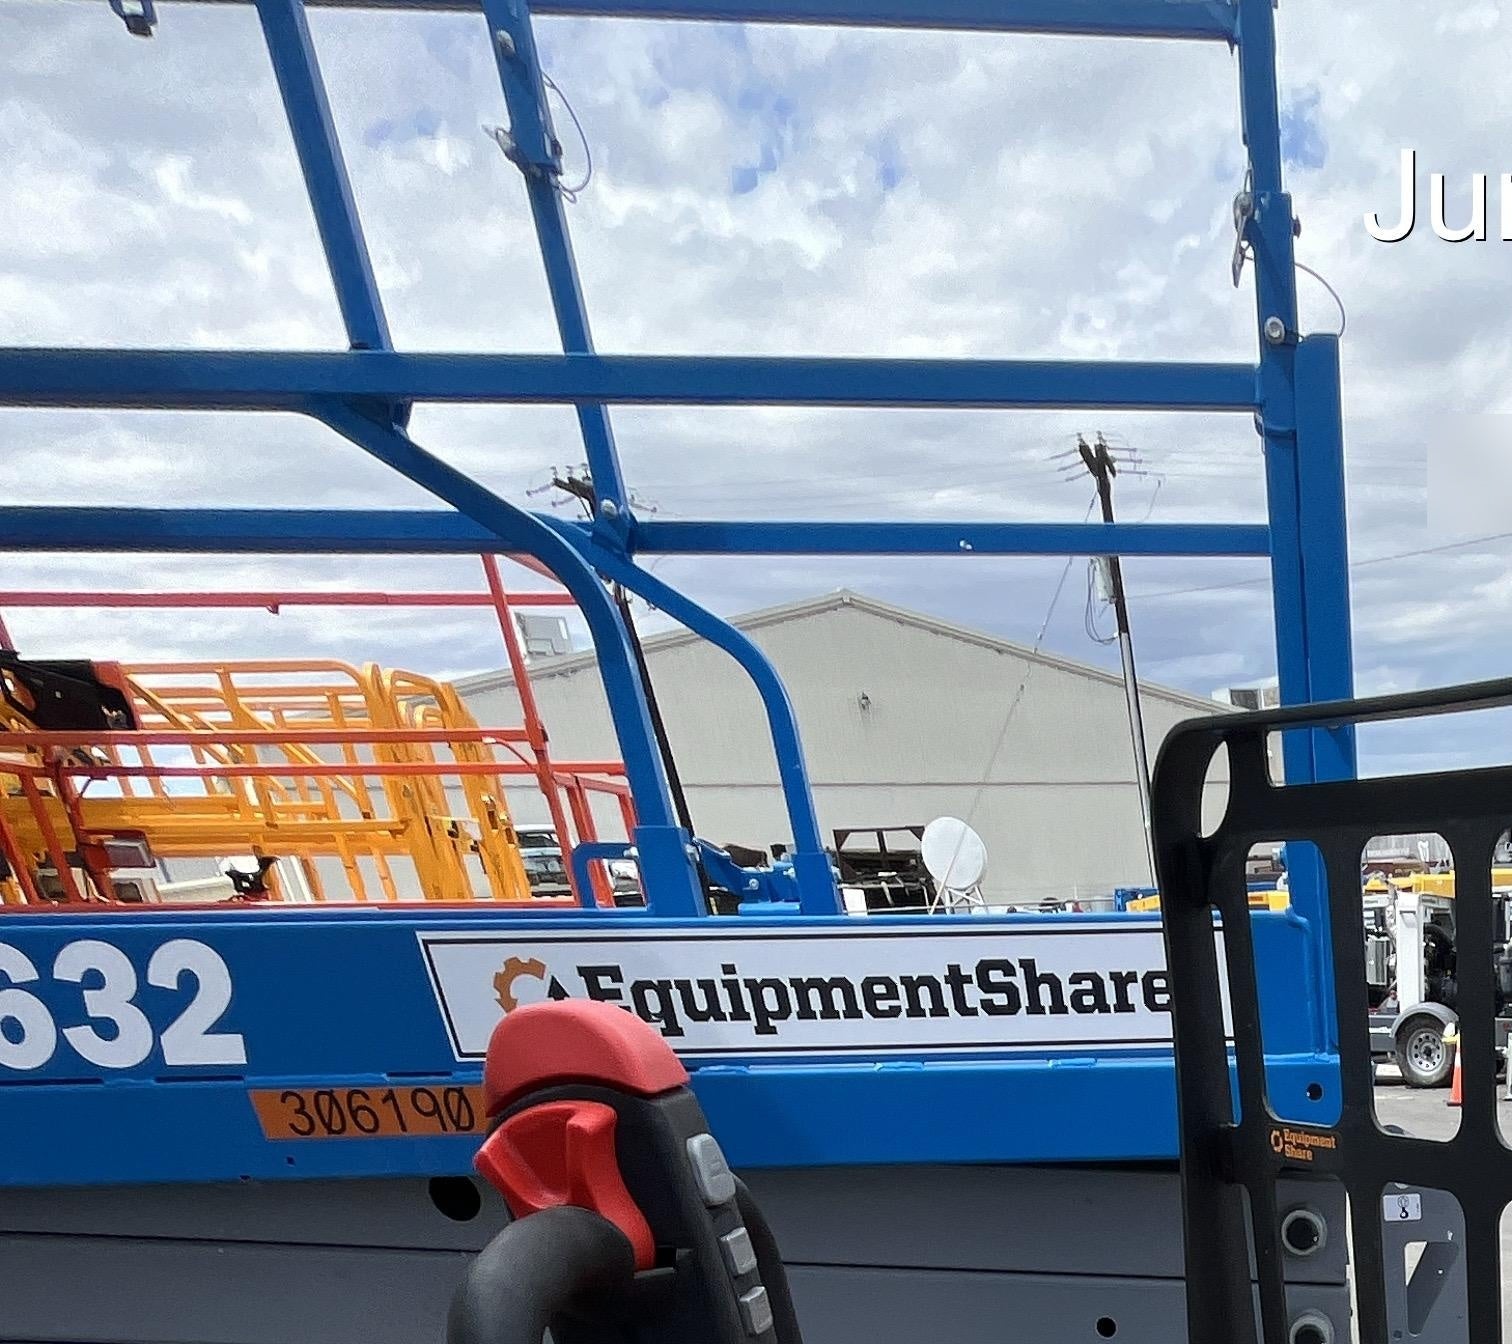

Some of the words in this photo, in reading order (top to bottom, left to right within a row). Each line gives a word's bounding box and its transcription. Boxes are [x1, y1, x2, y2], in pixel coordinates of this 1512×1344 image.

[576, 958, 1173, 1037] EquipmentShare
[279, 1086, 475, 1137] 306190
[1283, 1128, 1337, 1150] Equipment
[1284, 1144, 1313, 1161] Share
